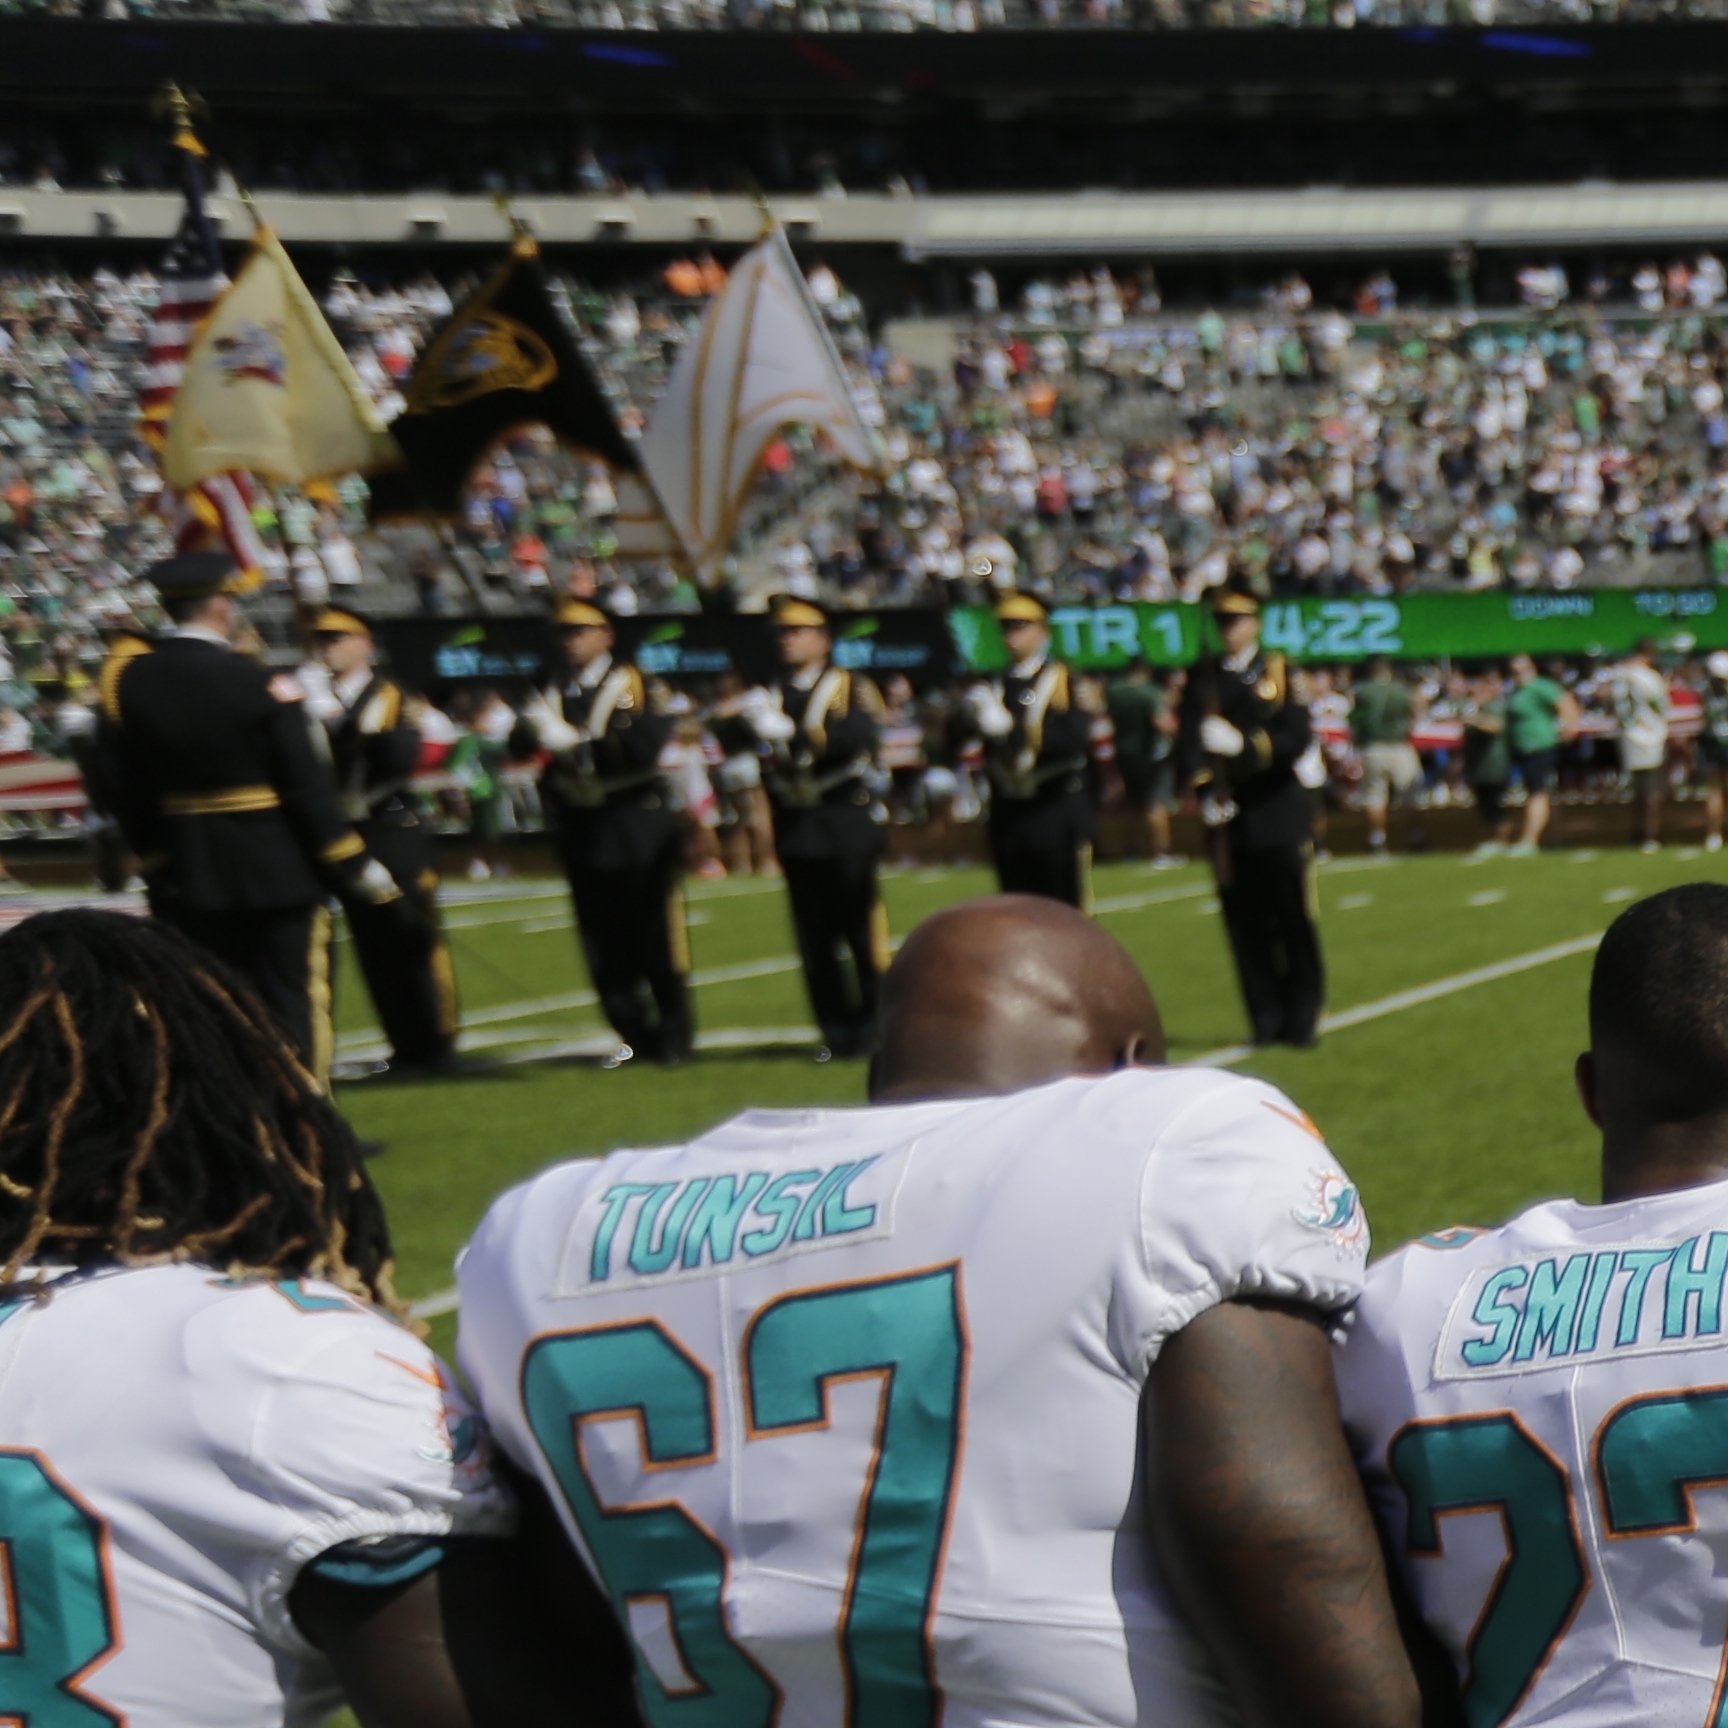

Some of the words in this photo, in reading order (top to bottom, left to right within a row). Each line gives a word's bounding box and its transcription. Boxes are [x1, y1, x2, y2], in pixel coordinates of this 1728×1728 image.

[1046, 606, 1141, 658] TR
[1153, 611, 1183, 656] 1
[1259, 600, 1404, 656] 4:22
[589, 1152, 884, 1283] TUNSIL
